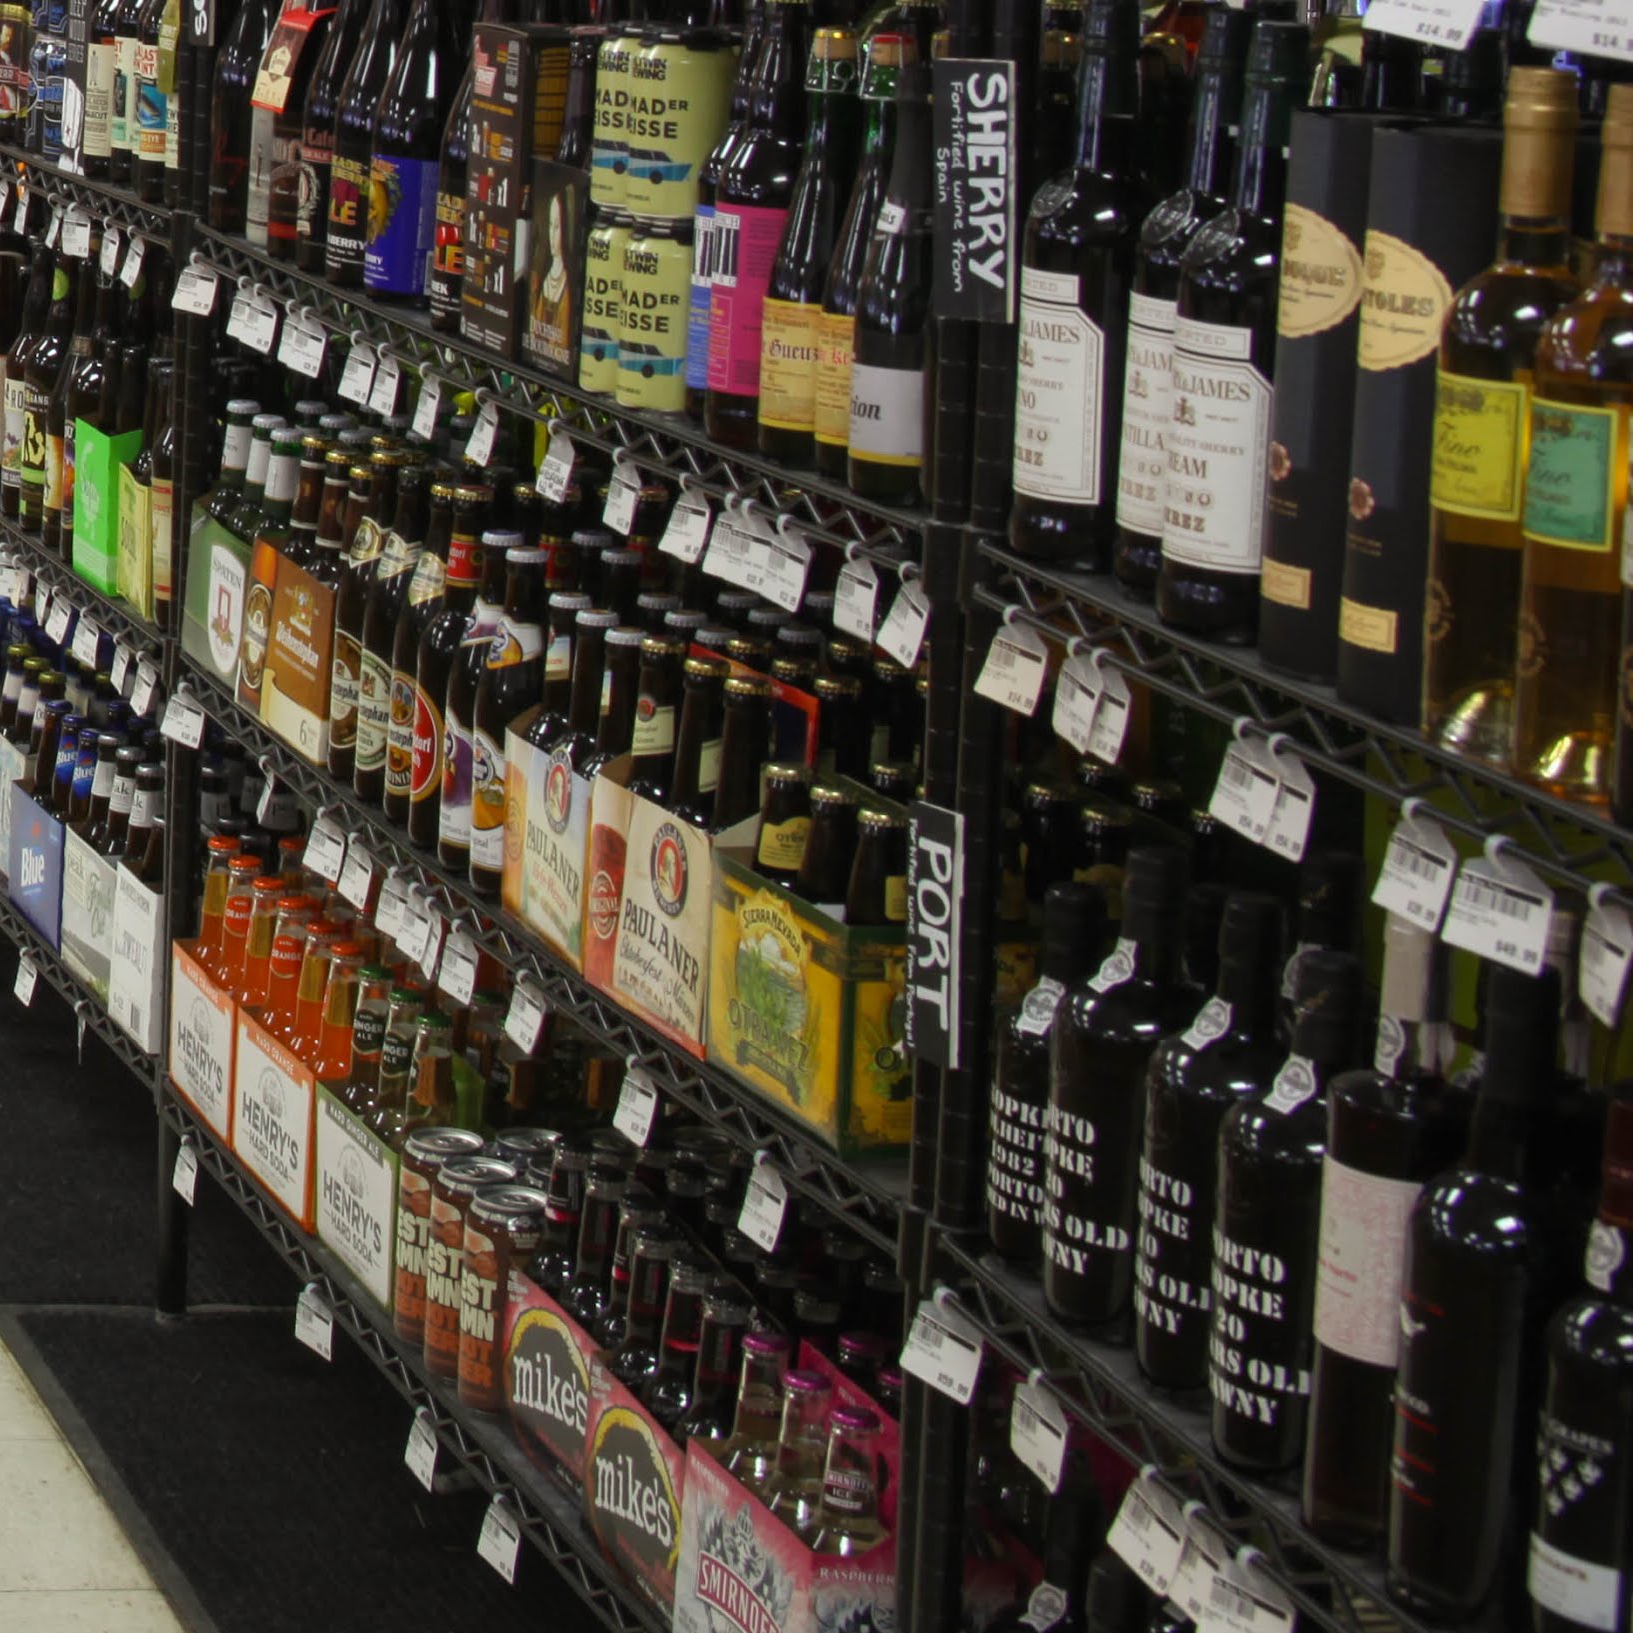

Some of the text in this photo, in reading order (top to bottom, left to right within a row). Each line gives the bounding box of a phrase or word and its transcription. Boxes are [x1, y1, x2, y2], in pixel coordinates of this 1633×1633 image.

[937, 148, 950, 203] Spain
[951, 82, 967, 293] Fortified wine from
[967, 72, 1007, 290] SHERRY
[213, 560, 243, 588] SPATEN
[21, 848, 45, 887] Blue
[527, 819, 581, 907] PAULANER
[623, 898, 699, 993] PAULANER
[905, 818, 917, 1049] Fortified wine Portugal
[916, 837, 952, 1032] PORT
[177, 1022, 224, 1093] HENRY'S
[184, 1060, 215, 1106] HARD SODA
[242, 1092, 299, 1165] HENRY'S
[249, 1129, 290, 1182] HARD SODA
[323, 1173, 383, 1254] HENRY'S
[331, 1212, 373, 1266] HARD SODA
[1066, 1214, 1128, 1250] OLD
[1217, 1305, 1245, 1341] 20
[512, 1352, 589, 1437] mike's
[595, 1455, 672, 1548] mike's
